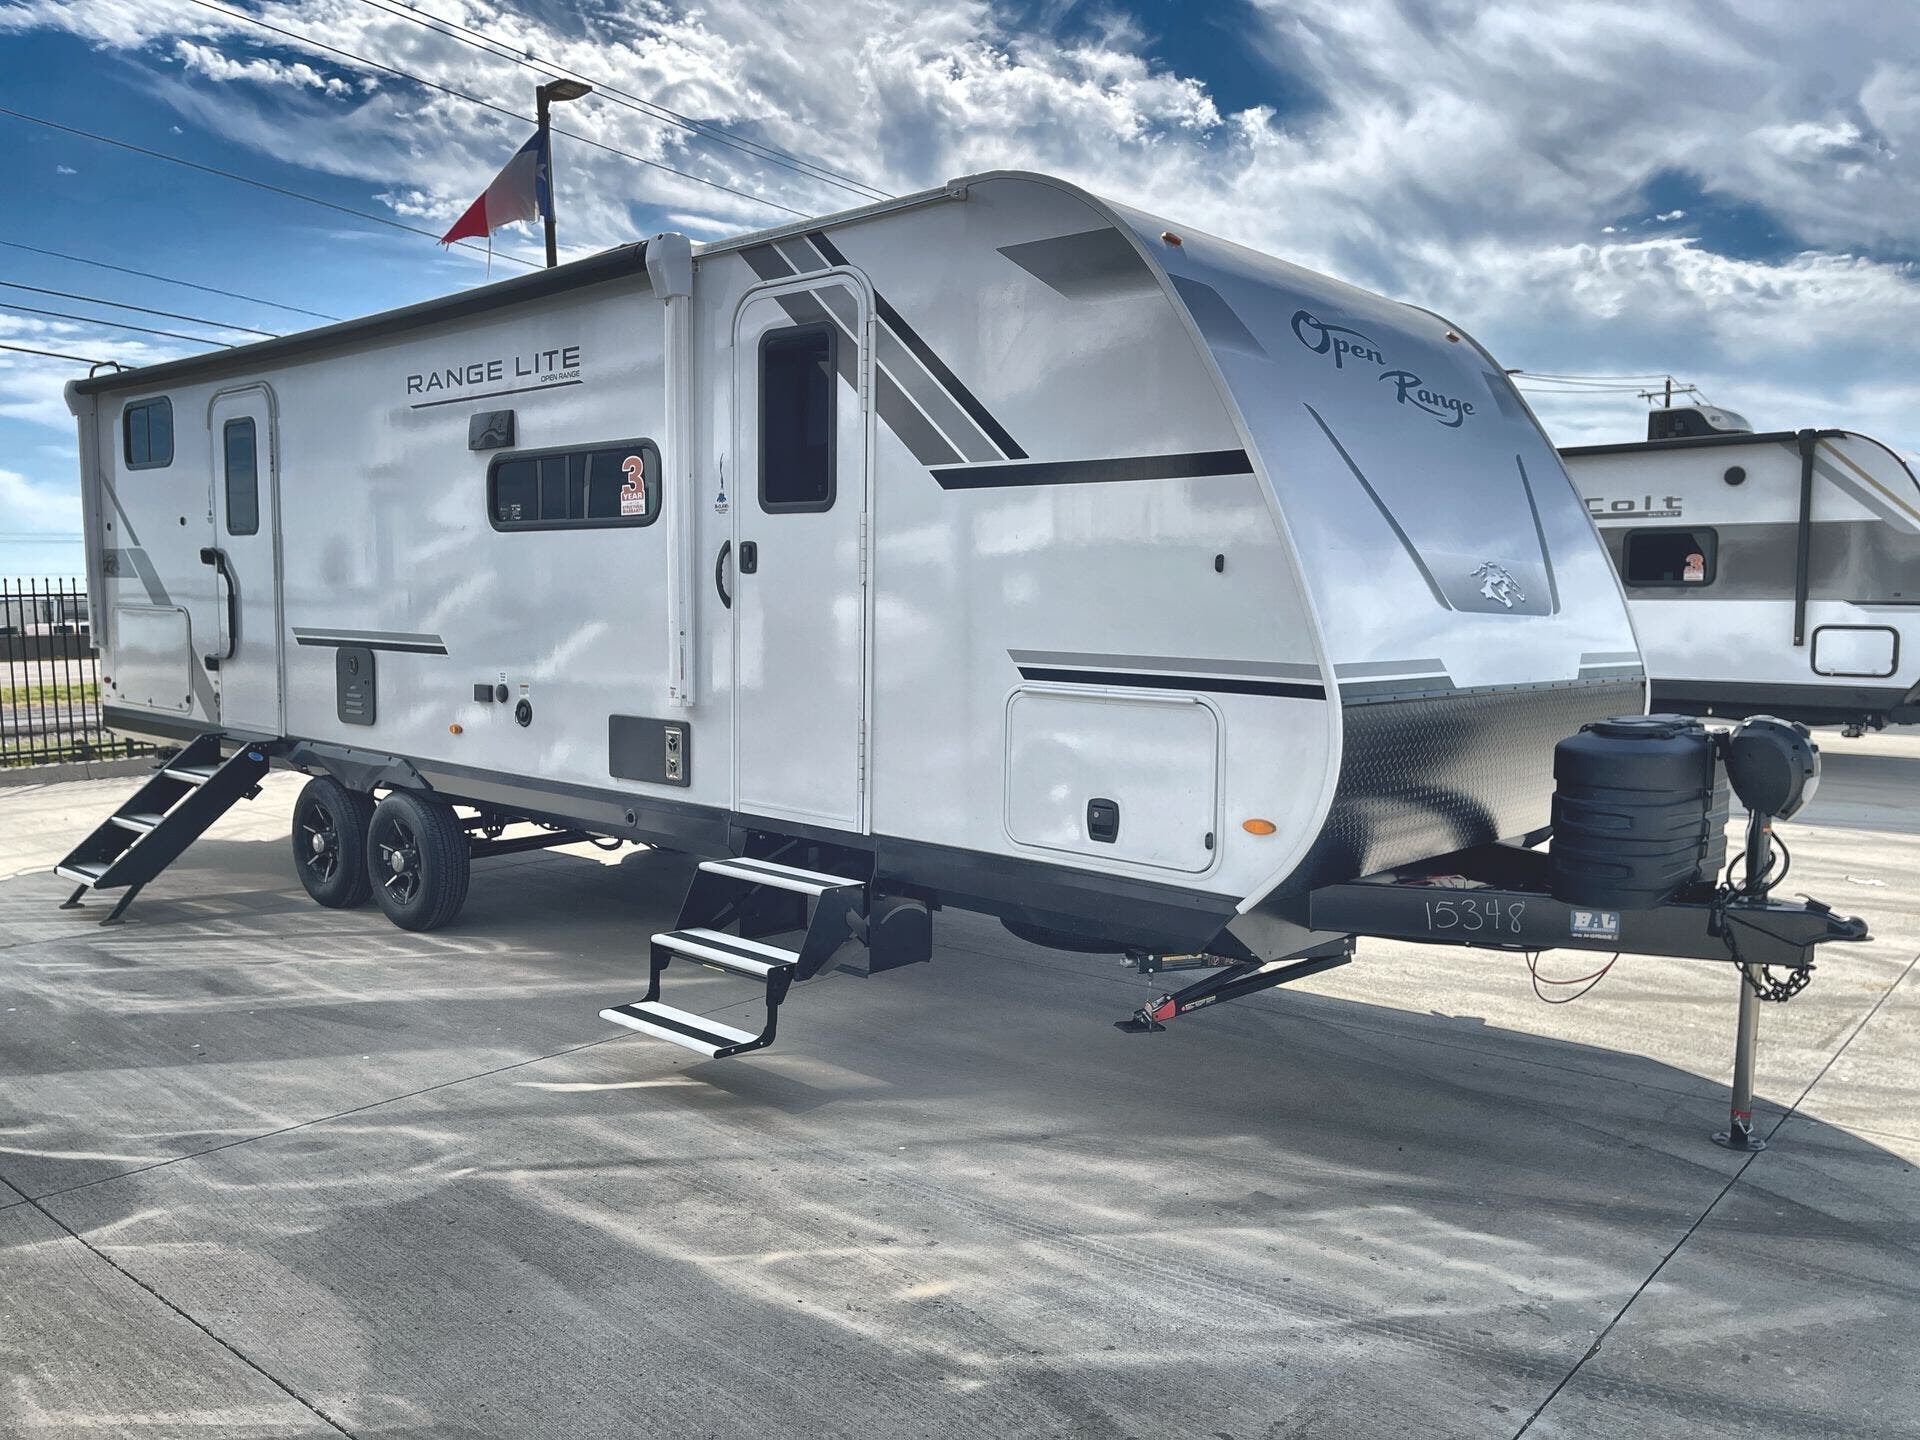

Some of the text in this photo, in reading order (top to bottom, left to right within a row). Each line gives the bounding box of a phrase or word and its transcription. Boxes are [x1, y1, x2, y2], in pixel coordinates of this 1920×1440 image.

[1291, 309, 1386, 369] Open
[407, 345, 580, 394] RANGE LITE
[541, 370, 580, 382] OPEN RANGE
[1378, 370, 1476, 428] Range
[622, 456, 644, 492] 3
[622, 492, 643, 500] YEAR
[1426, 899, 1525, 933] 15348
